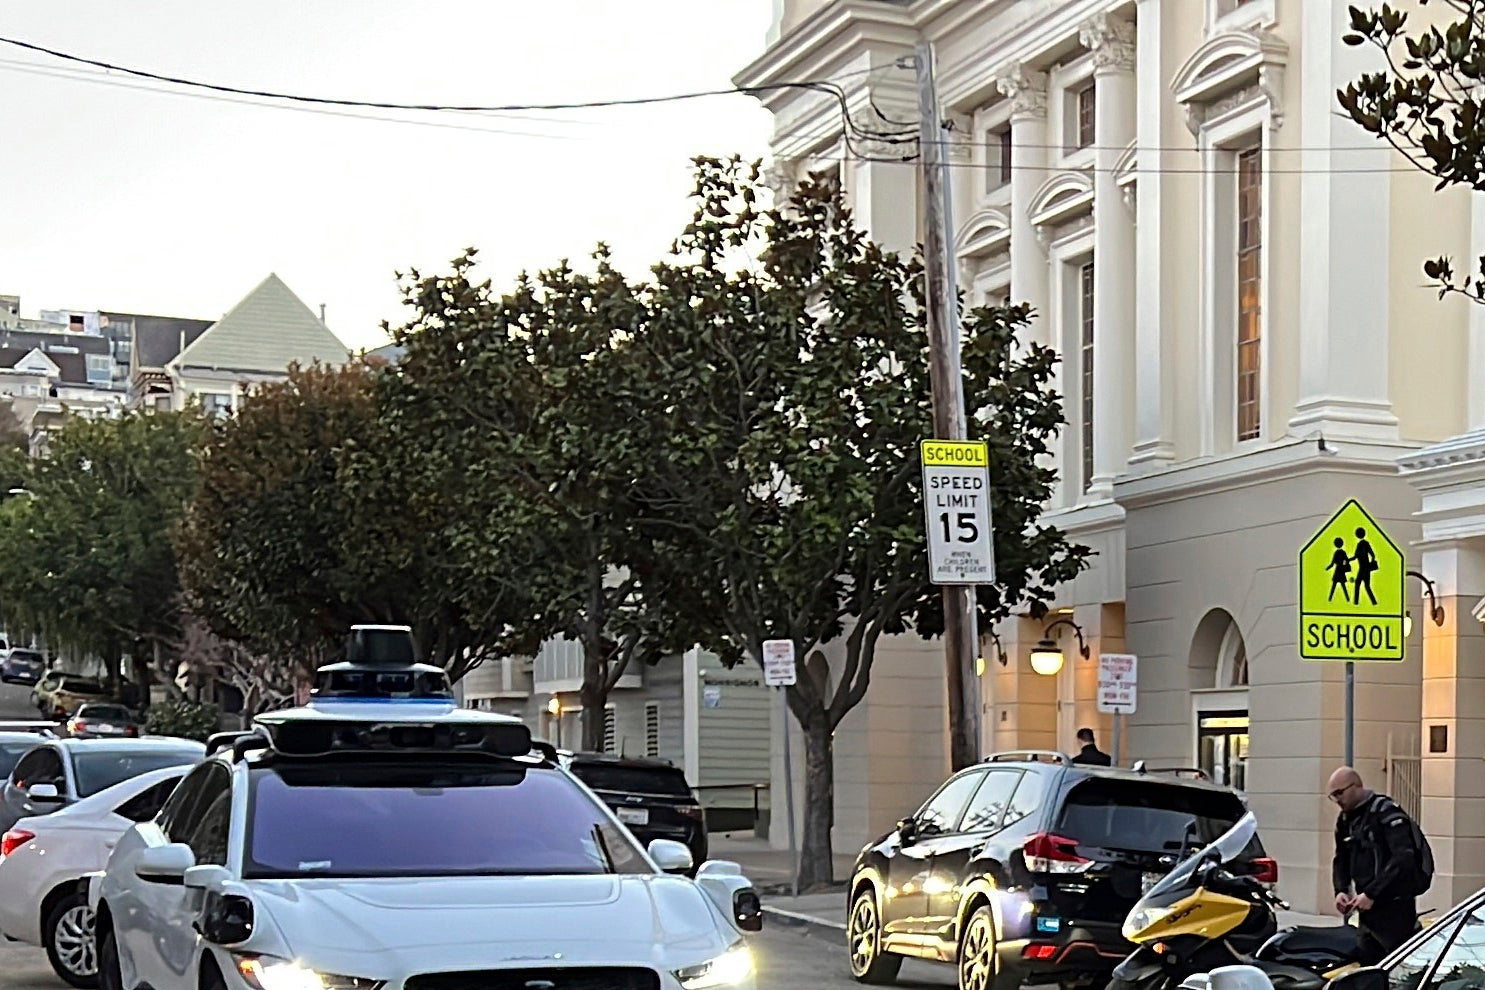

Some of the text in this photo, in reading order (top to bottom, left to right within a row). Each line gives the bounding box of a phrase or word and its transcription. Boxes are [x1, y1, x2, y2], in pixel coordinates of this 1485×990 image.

[926, 447, 982, 461] SCHOOL
[930, 476, 982, 489] SPEED
[937, 494, 978, 508] LIMIT
[940, 512, 978, 543] 15
[1307, 623, 1397, 649] SCHOOL
